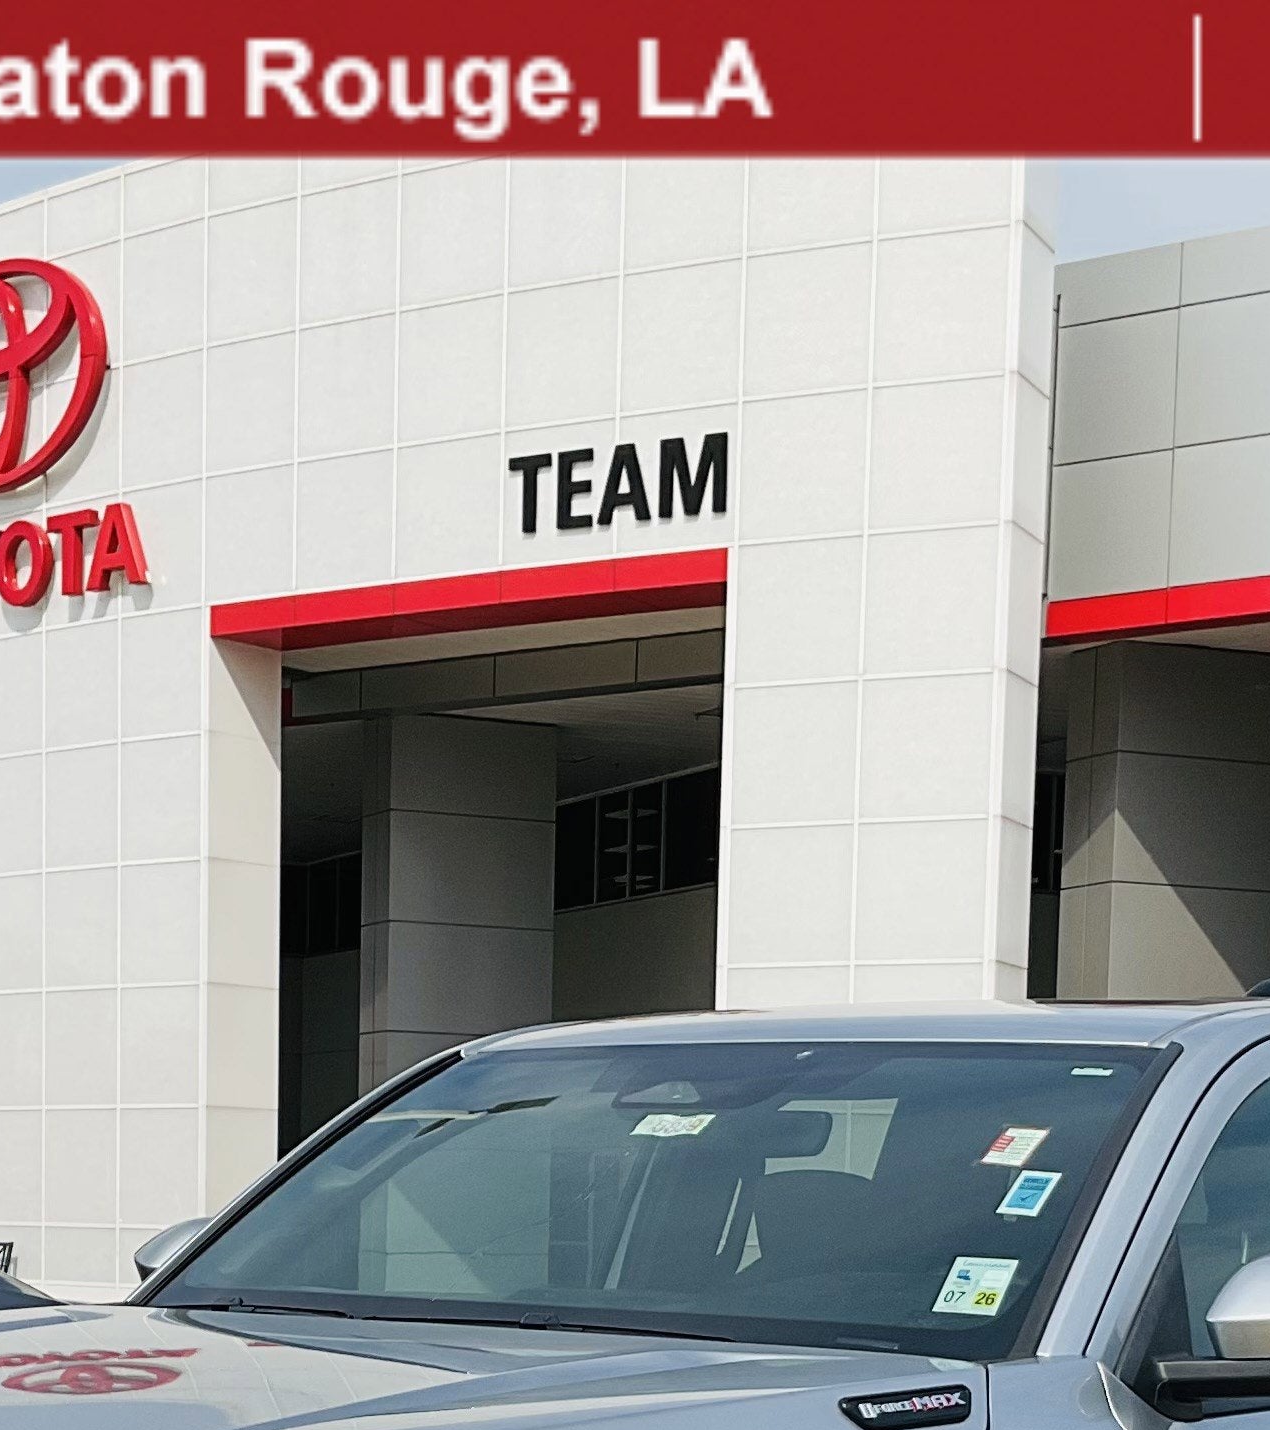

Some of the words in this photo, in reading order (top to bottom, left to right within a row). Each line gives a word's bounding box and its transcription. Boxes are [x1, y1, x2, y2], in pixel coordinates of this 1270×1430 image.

[509, 432, 729, 534] TEAM
[943, 1290, 966, 1303] 07
[974, 1292, 997, 1306] 26
